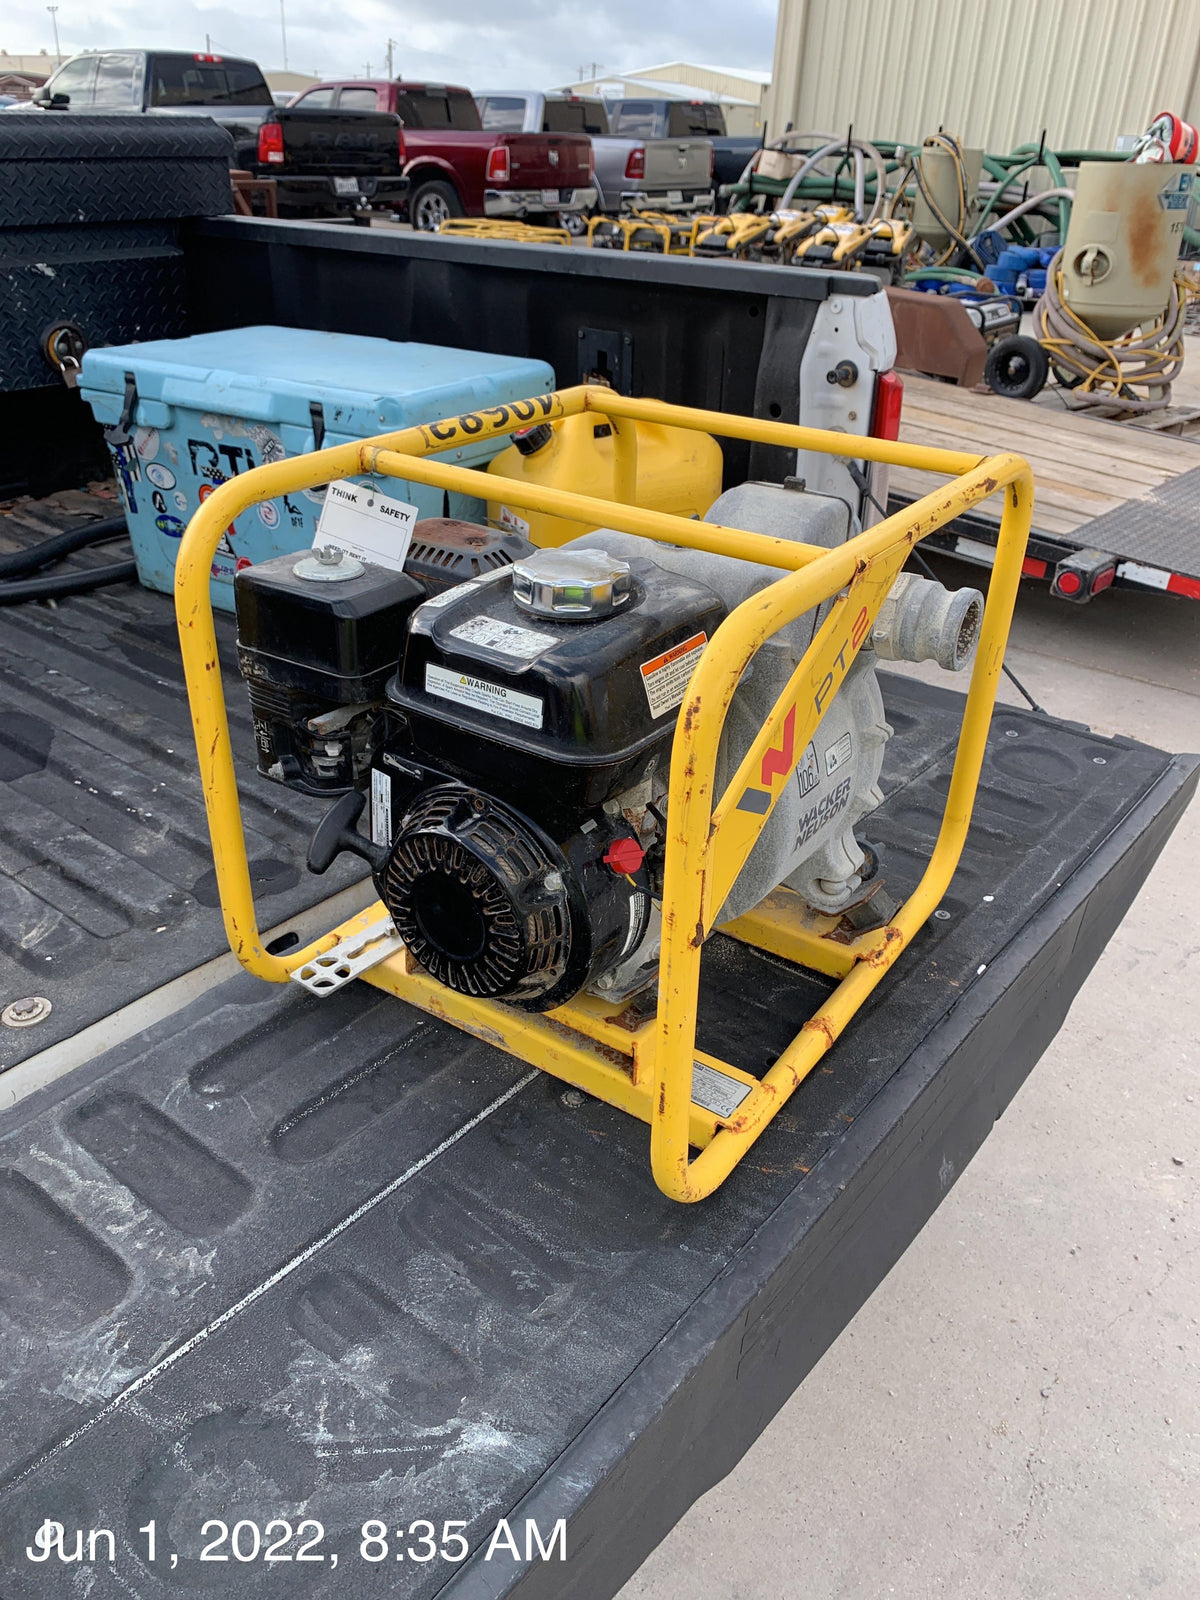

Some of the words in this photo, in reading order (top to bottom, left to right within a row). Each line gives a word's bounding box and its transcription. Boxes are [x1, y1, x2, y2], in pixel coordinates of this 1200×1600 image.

[263, 440, 275, 454] YETI
[331, 487, 358, 503] THINK
[379, 505, 411, 522] SAFETY
[669, 645, 688, 660] WARNING
[466, 678, 507, 698] WARNING
[800, 765, 814, 793] 106
[798, 776, 852, 833] WACKER
[791, 791, 850, 856] NEUSON
